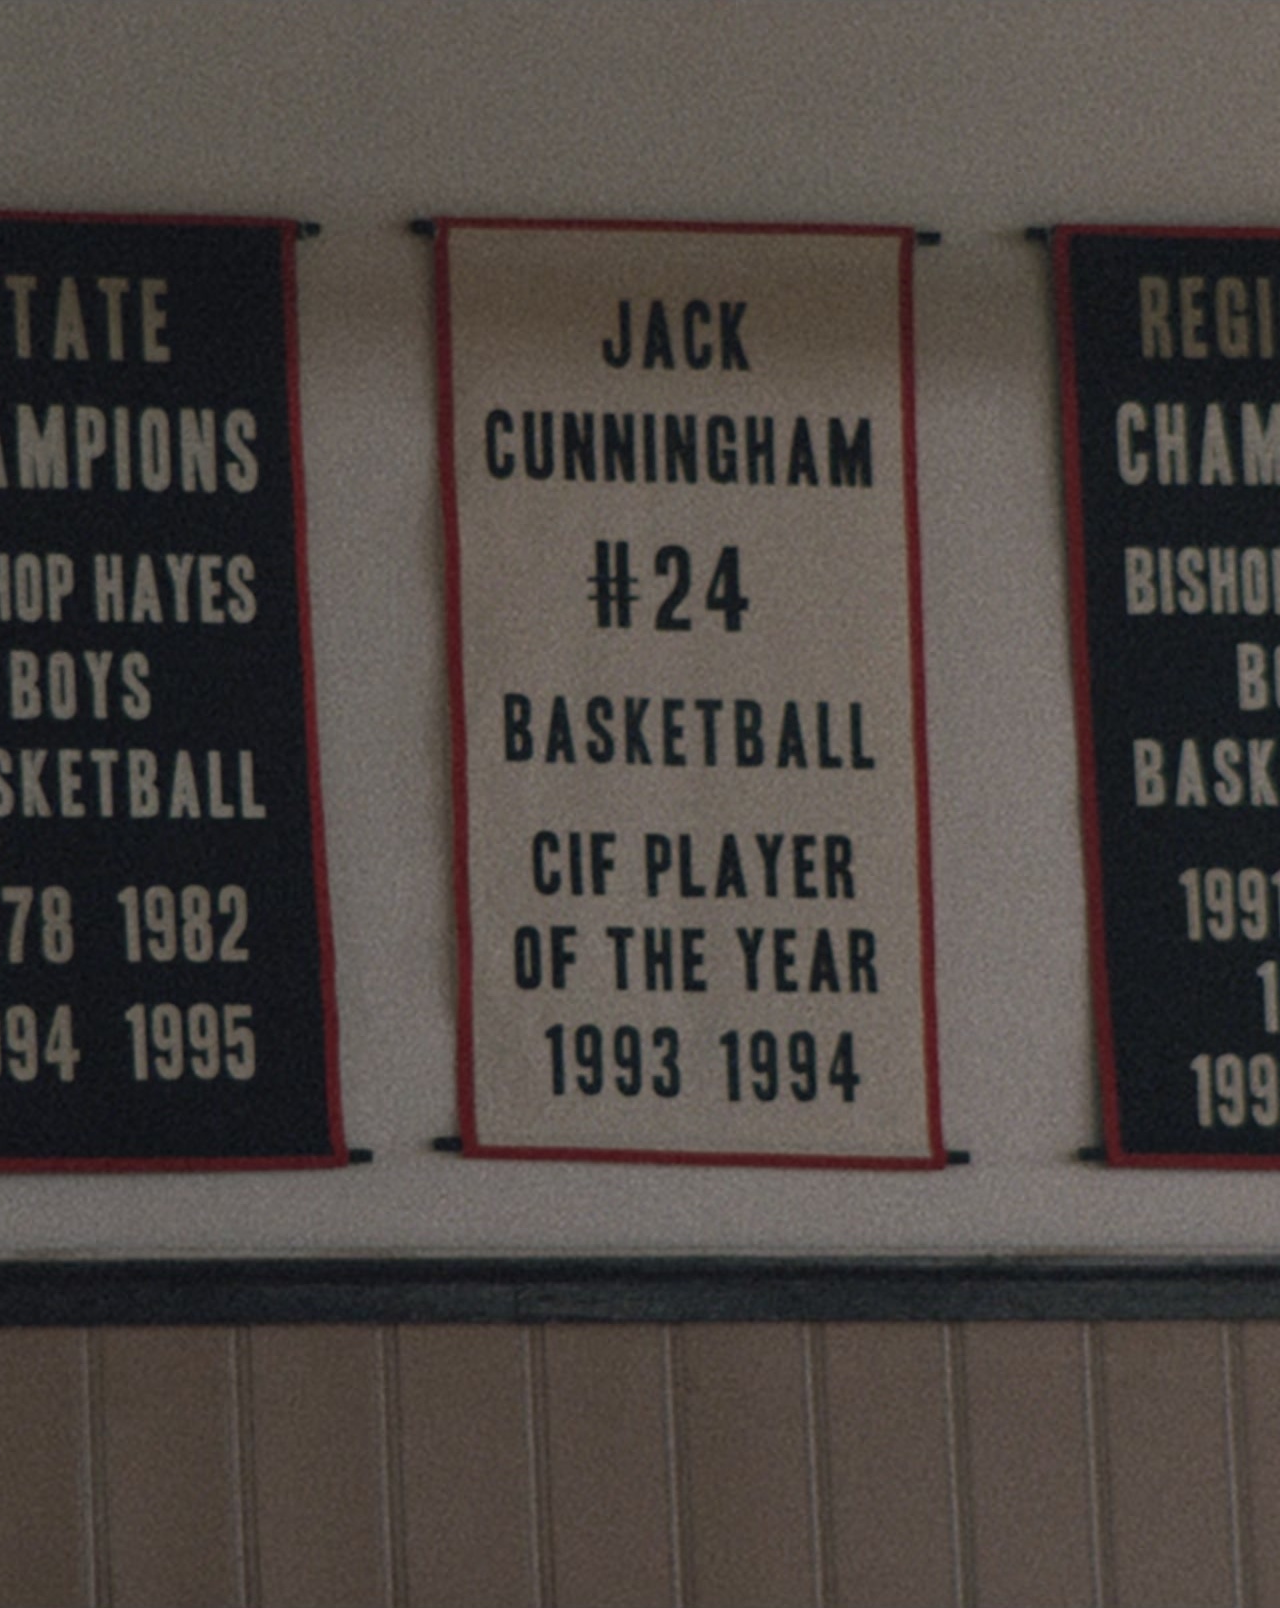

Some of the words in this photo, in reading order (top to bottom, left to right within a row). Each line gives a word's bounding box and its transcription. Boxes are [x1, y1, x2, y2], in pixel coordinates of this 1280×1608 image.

[601, 298, 751, 372] JACK
[484, 409, 874, 488] CUNNINGHAM
[94, 553, 258, 624] HAYES
[587, 540, 751, 633] #24
[8, 650, 152, 720] BOYS
[502, 693, 876, 770] BASKETBALL
[531, 830, 617, 897] CIF
[645, 832, 856, 900] PLAYER
[116, 884, 250, 964] 1982
[514, 925, 577, 991] OF
[606, 927, 708, 993] THE
[736, 928, 879, 994] YEAR
[124, 1003, 257, 1081] 1995
[544, 1024, 682, 1097] 1993
[720, 1029, 861, 1103] 1994
